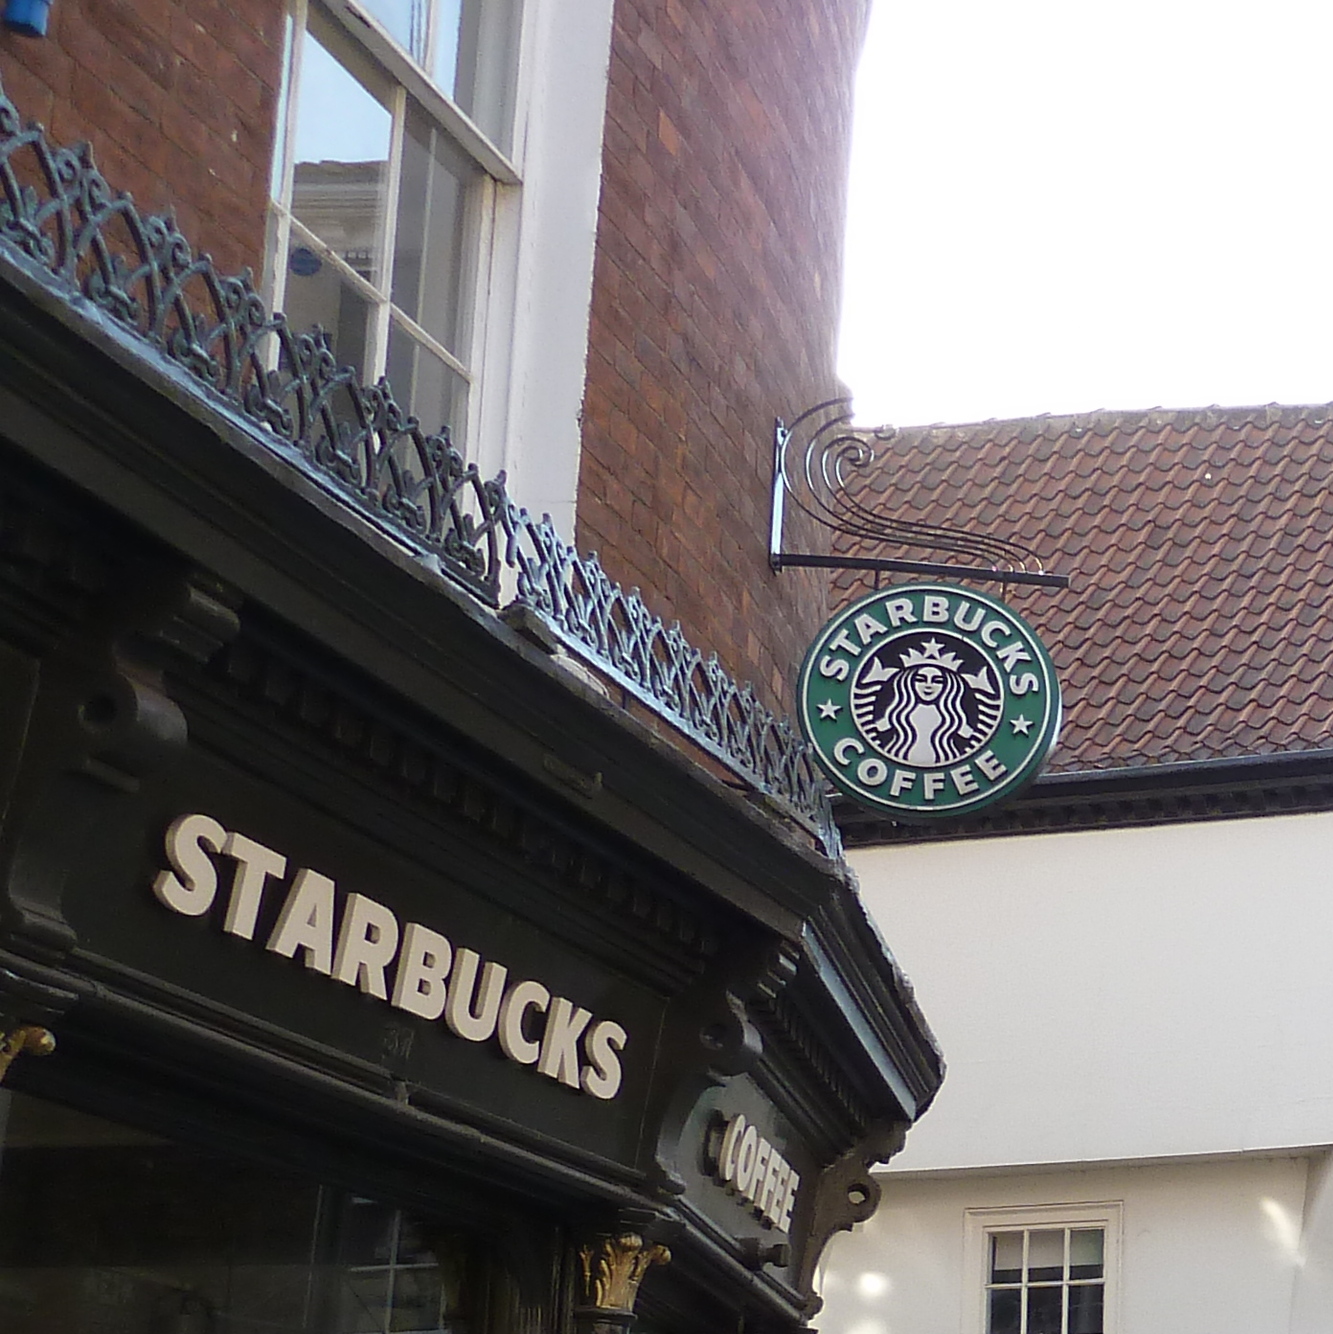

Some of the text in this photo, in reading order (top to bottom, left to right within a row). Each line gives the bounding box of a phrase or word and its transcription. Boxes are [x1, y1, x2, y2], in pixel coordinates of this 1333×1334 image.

[819, 595, 1038, 695] STARBUCKS
[834, 737, 1007, 799] COFFEE
[153, 813, 628, 1100] STARBUCKS
[719, 1114, 800, 1234] COFFEE
